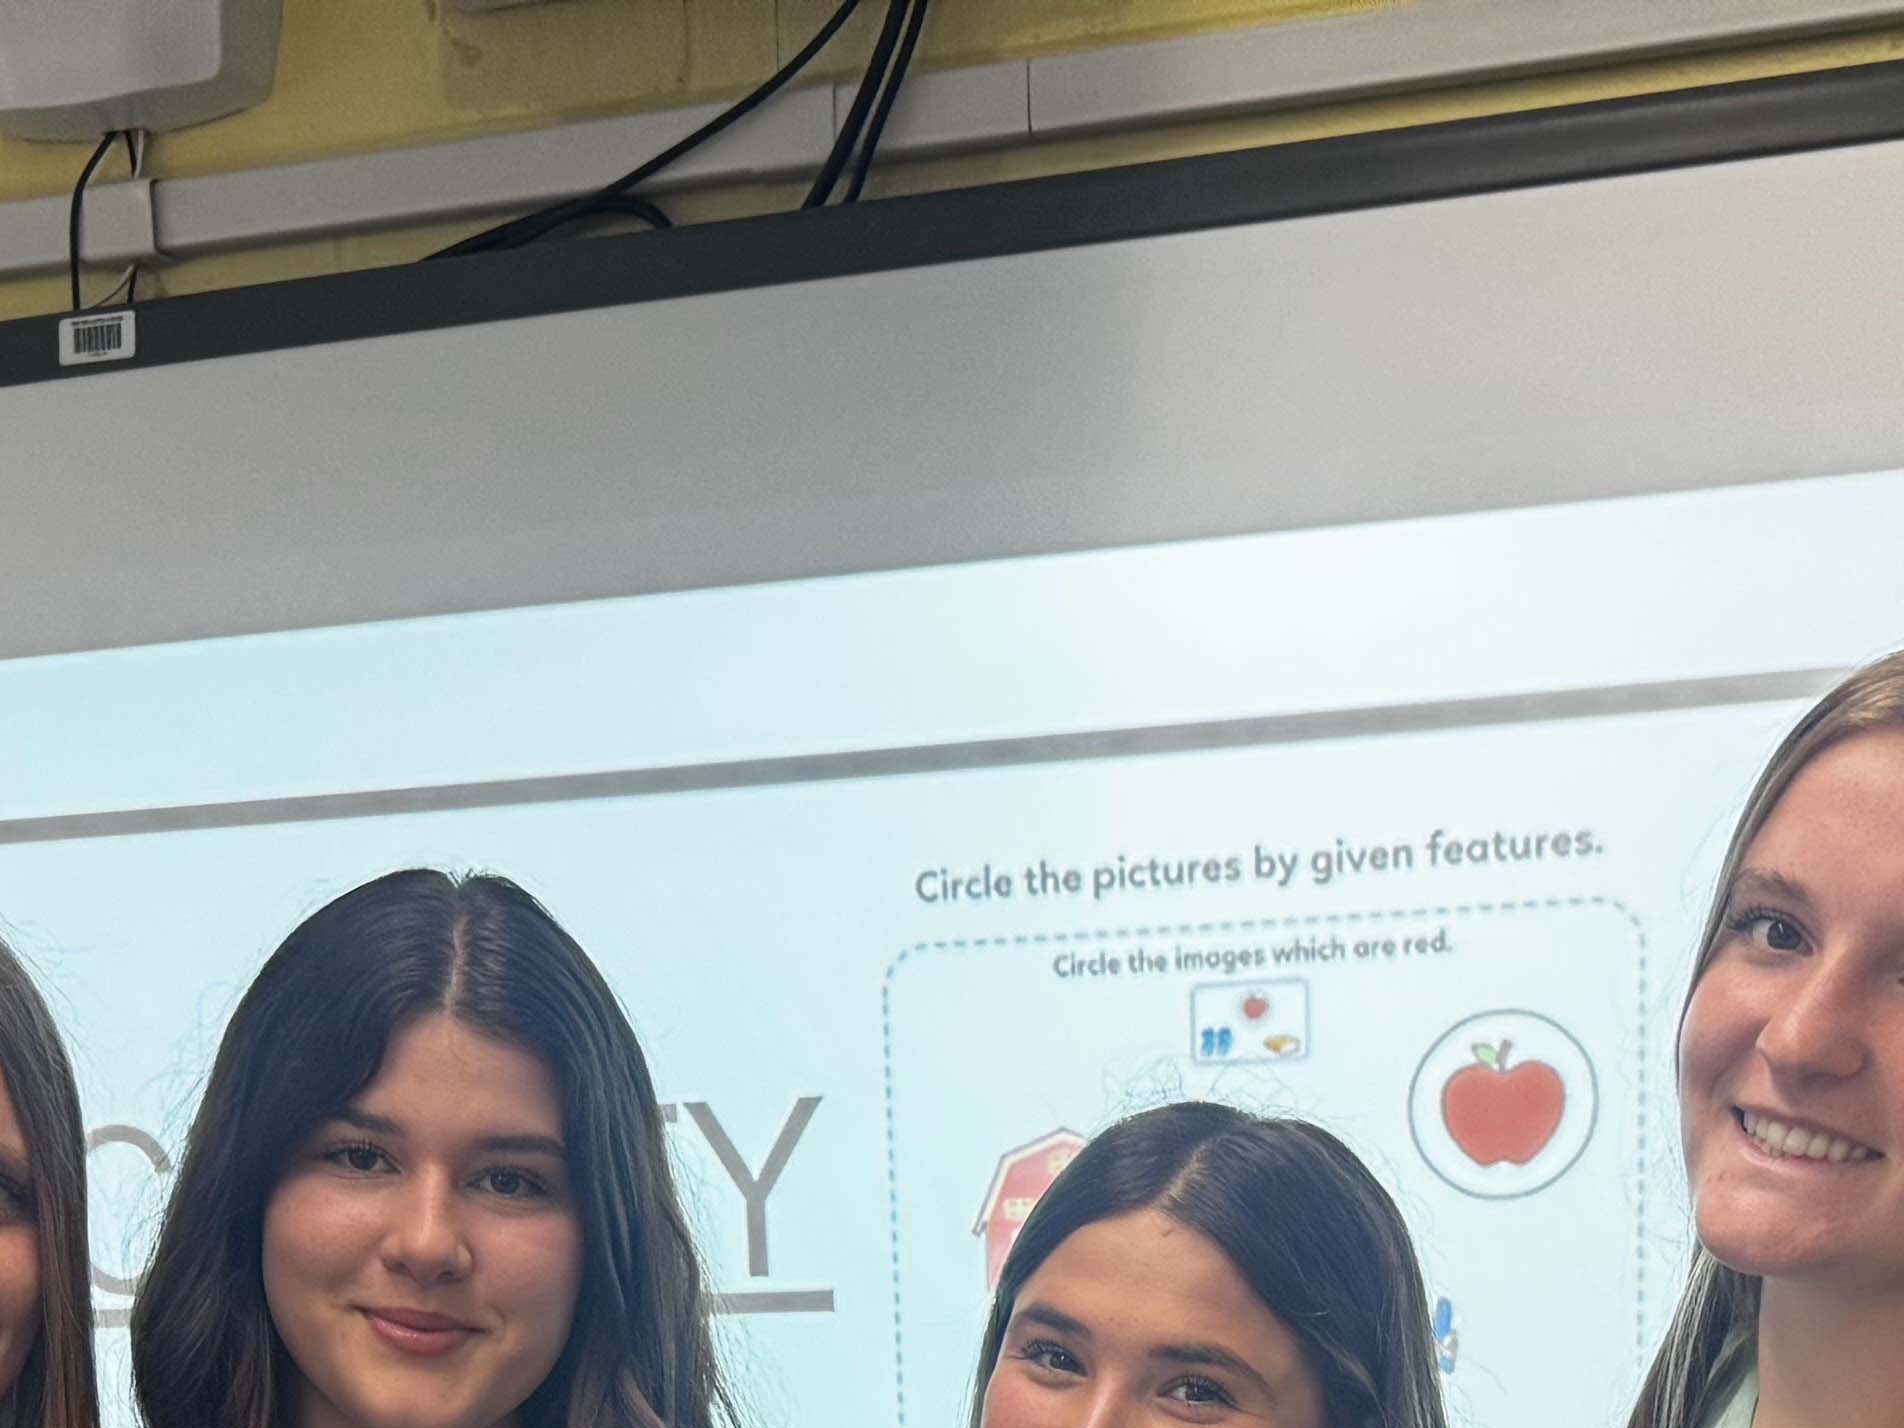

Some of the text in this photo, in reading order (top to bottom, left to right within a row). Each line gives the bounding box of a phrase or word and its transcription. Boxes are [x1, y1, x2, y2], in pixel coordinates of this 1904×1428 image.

[915, 828, 1605, 904] Circle the pictures by given features.
[1052, 928, 1454, 980] Circle the images which are red.
